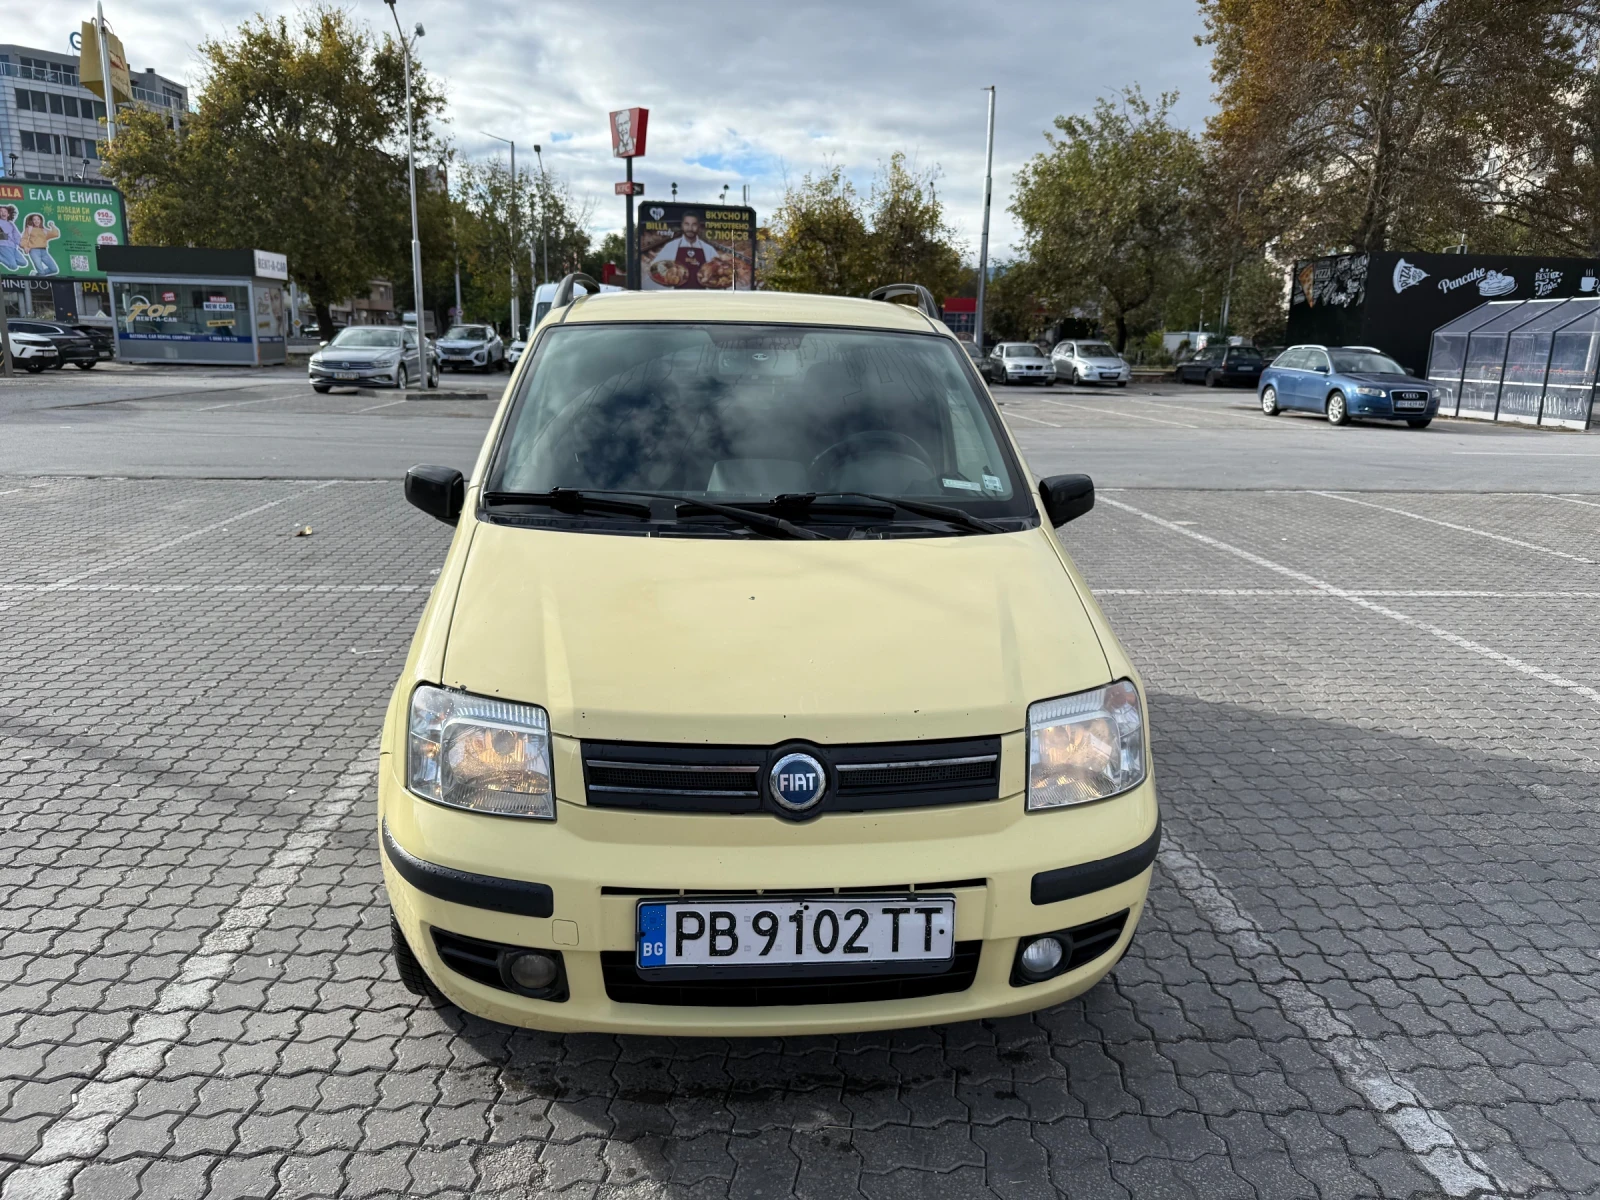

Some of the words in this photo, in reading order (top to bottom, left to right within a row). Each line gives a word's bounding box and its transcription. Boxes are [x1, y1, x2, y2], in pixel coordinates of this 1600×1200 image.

[0, 187, 22, 198] LLA
[29, 188, 53, 201] ЕЛА
[57, 190, 65, 202] В
[70, 191, 112, 205] ЕКИПА!
[706, 211, 740, 220] ВКУСНО
[743, 212, 749, 220] И
[657, 228, 675, 238] ready
[706, 231, 713, 240] С
[258, 258, 286, 272] RENT-A-CAR
[1438, 267, 1486, 294] Pancake
[126, 304, 177, 323] TOP
[779, 773, 816, 792] FIAT
[675, 910, 739, 957] PB
[752, 908, 869, 956] 9102
[882, 907, 943, 953] TT
[643, 942, 664, 957] BG
